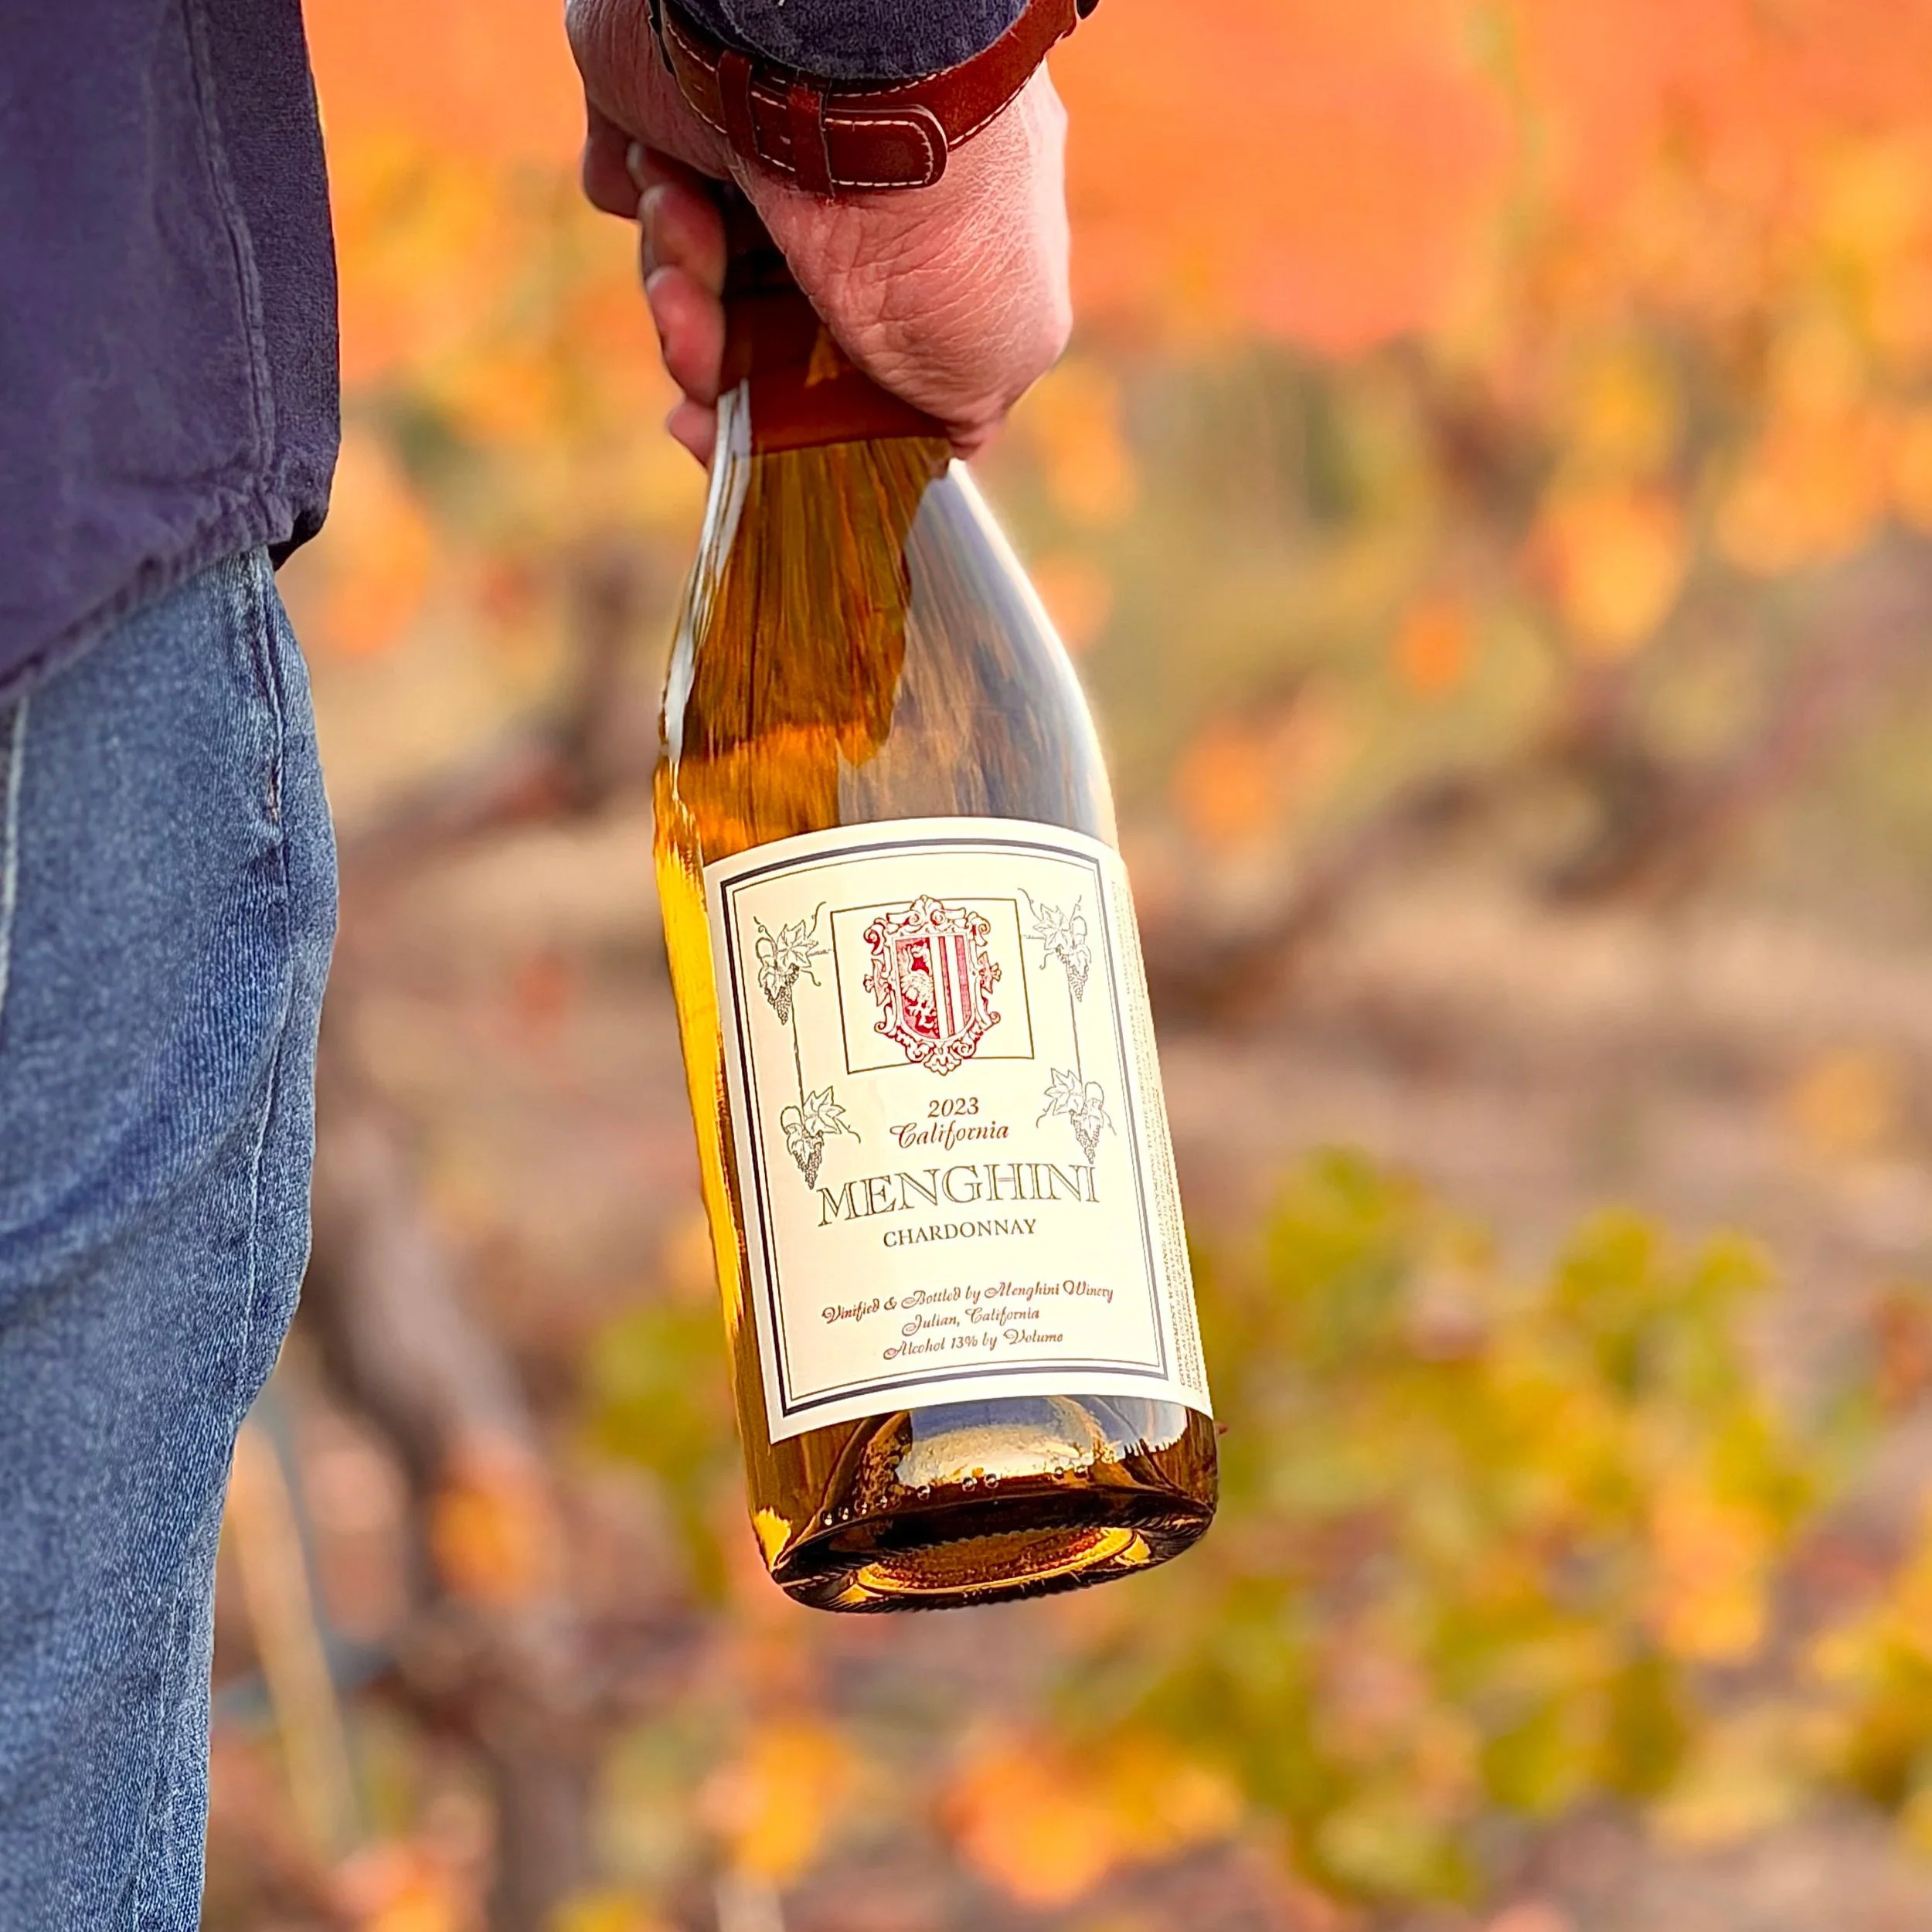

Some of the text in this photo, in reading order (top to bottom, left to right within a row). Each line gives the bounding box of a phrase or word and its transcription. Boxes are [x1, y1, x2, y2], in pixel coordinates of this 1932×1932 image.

[927, 1097, 979, 1118] 2023
[889, 1121, 1009, 1151] California
[817, 1162, 1100, 1227] MENGHINI
[883, 1219, 1037, 1248] CHARDONNAY
[821, 1280, 1114, 1325] Vinified & Bottled by Menghini Winery
[901, 1306, 1040, 1337] Julian, California
[883, 1328, 1063, 1360] Alcohol 13% by Volume
